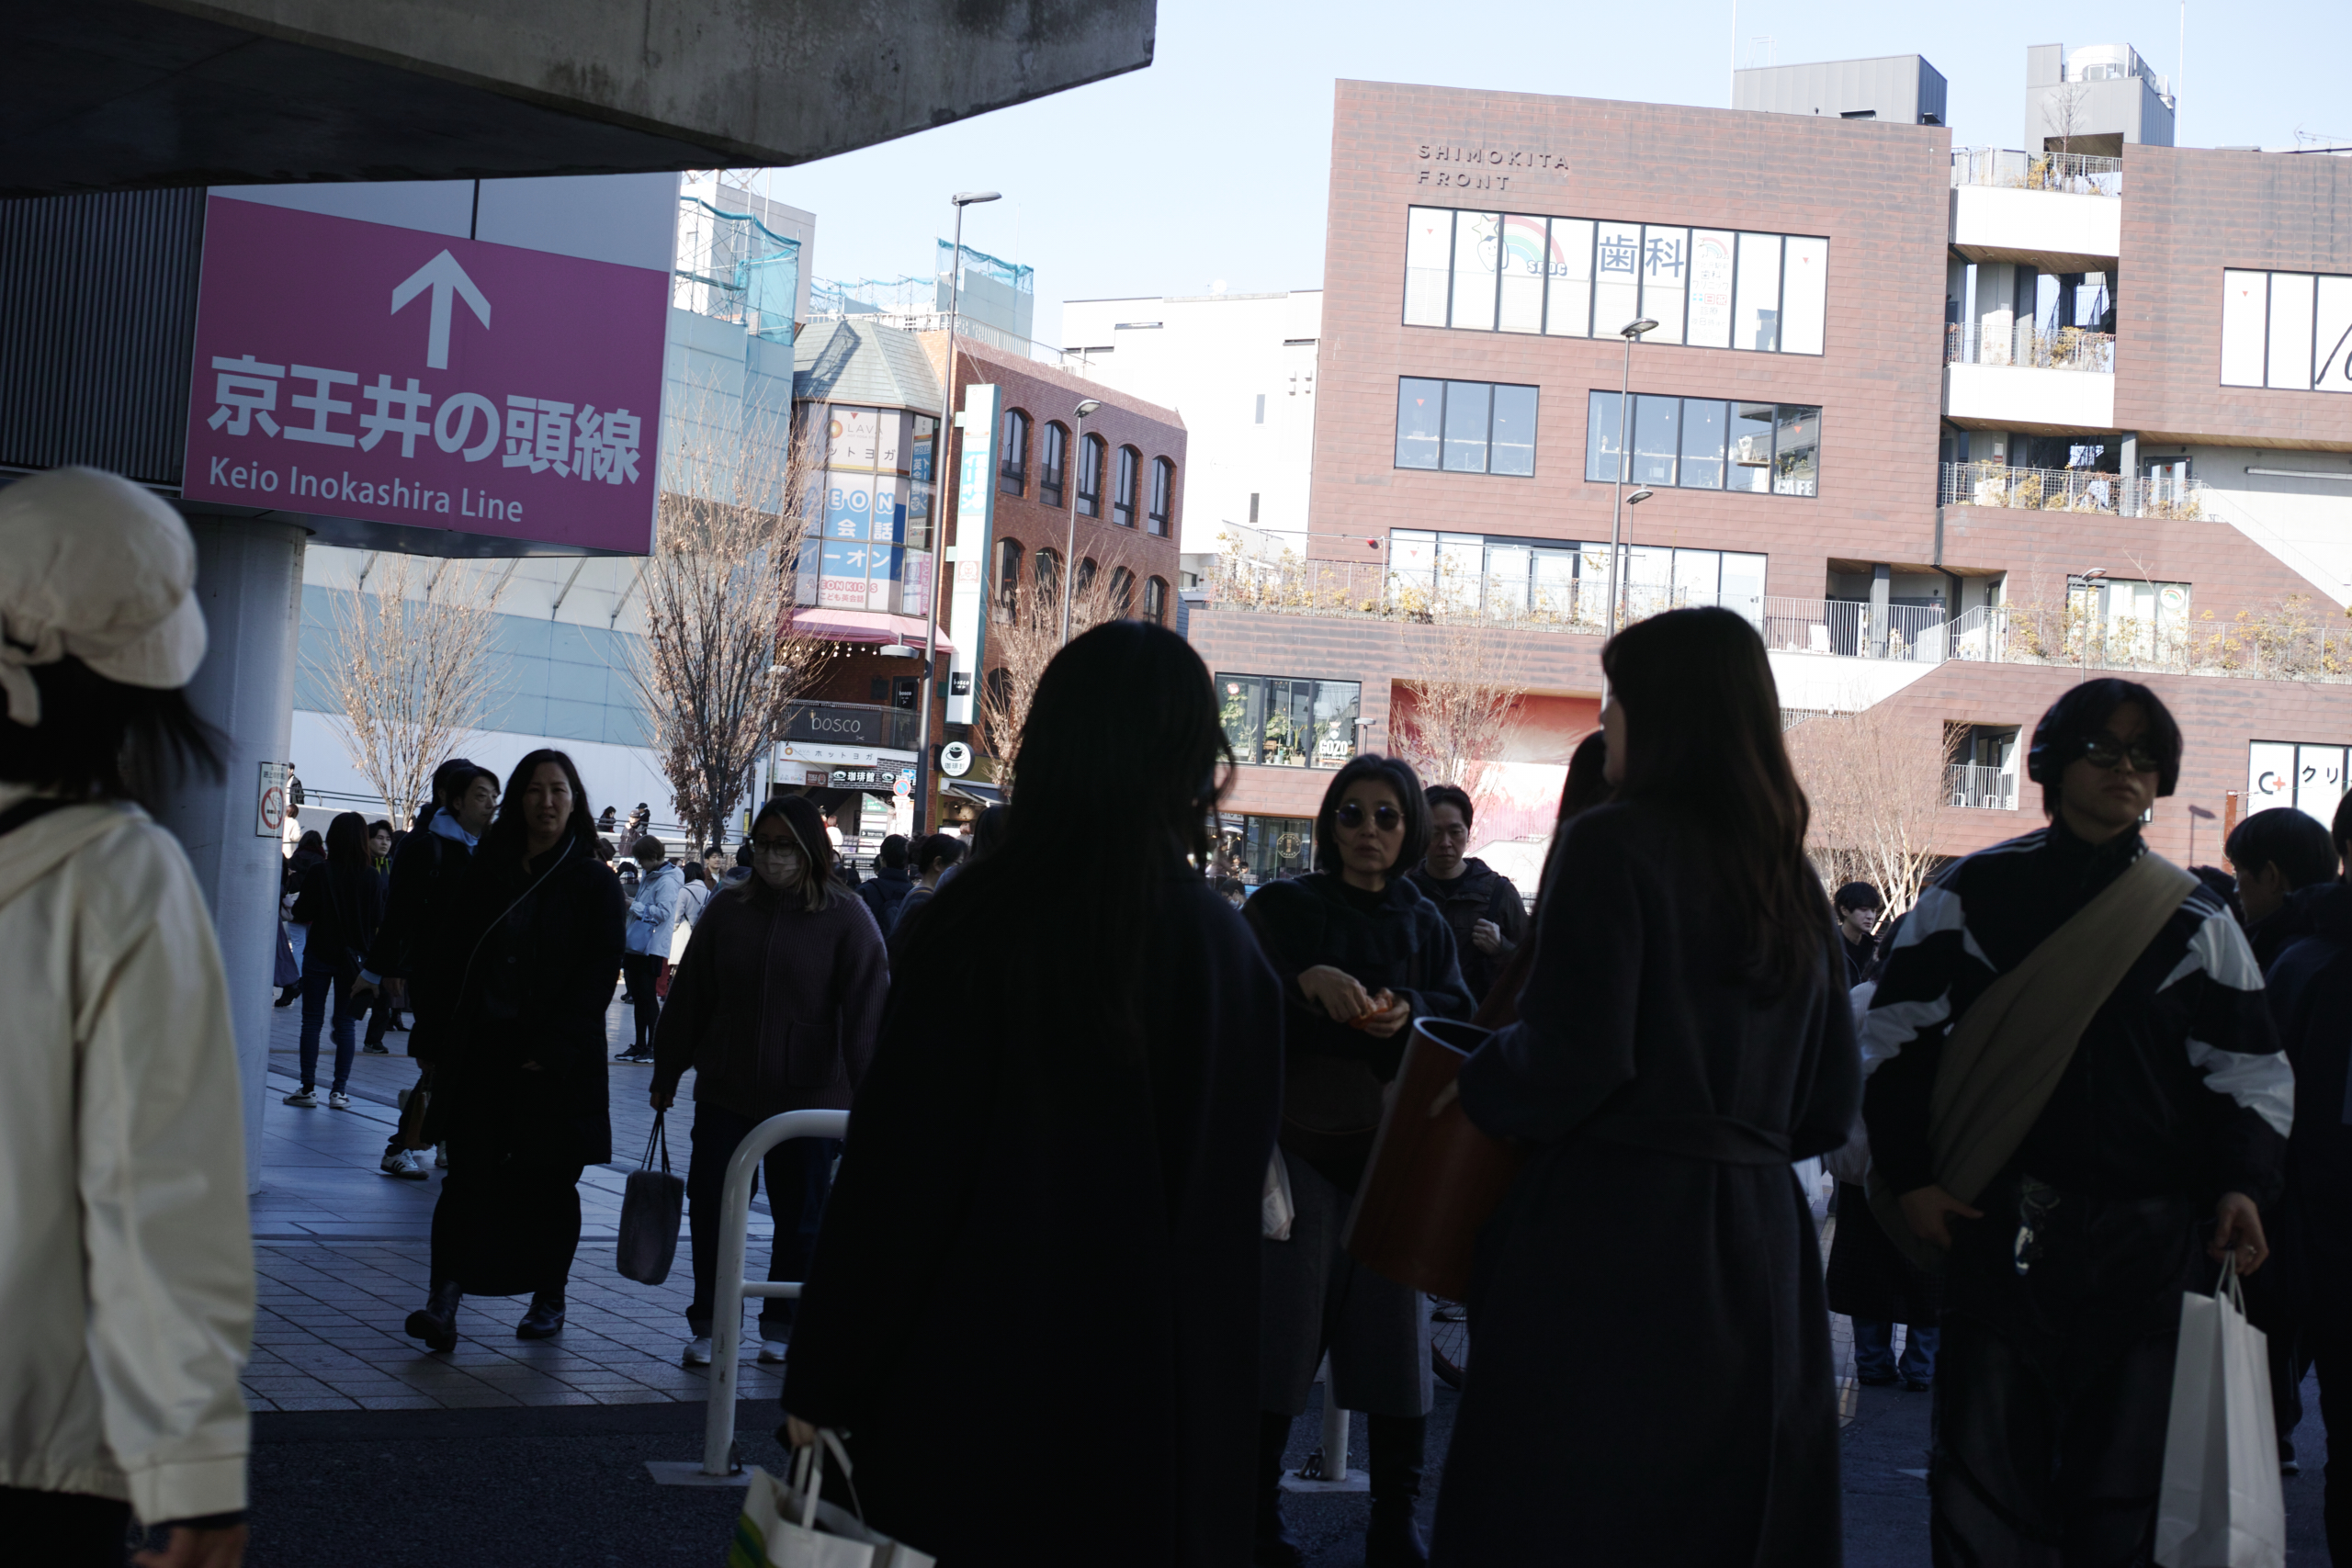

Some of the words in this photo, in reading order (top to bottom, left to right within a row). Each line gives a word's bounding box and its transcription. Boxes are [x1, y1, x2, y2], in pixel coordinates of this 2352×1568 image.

[1418, 145, 1569, 171] SHIMOKITA
[1418, 171, 1510, 191] FRONT
[1599, 234, 1685, 278] 歯科
[207, 354, 642, 486] 京王井の頭線
[847, 423, 884, 435] LAVA
[209, 456, 279, 492] Keio
[289, 466, 451, 514] Inokashira
[461, 487, 524, 523] Line
[1774, 479, 1813, 496] CAFE
[820, 592, 865, 604] こども英会話
[811, 714, 861, 733] bosco
[815, 750, 874, 761] ホットヨガ
[1318, 739, 1349, 756] GOZO
[847, 771, 876, 783] 珈琲館
[2302, 765, 2339, 784] クリ
